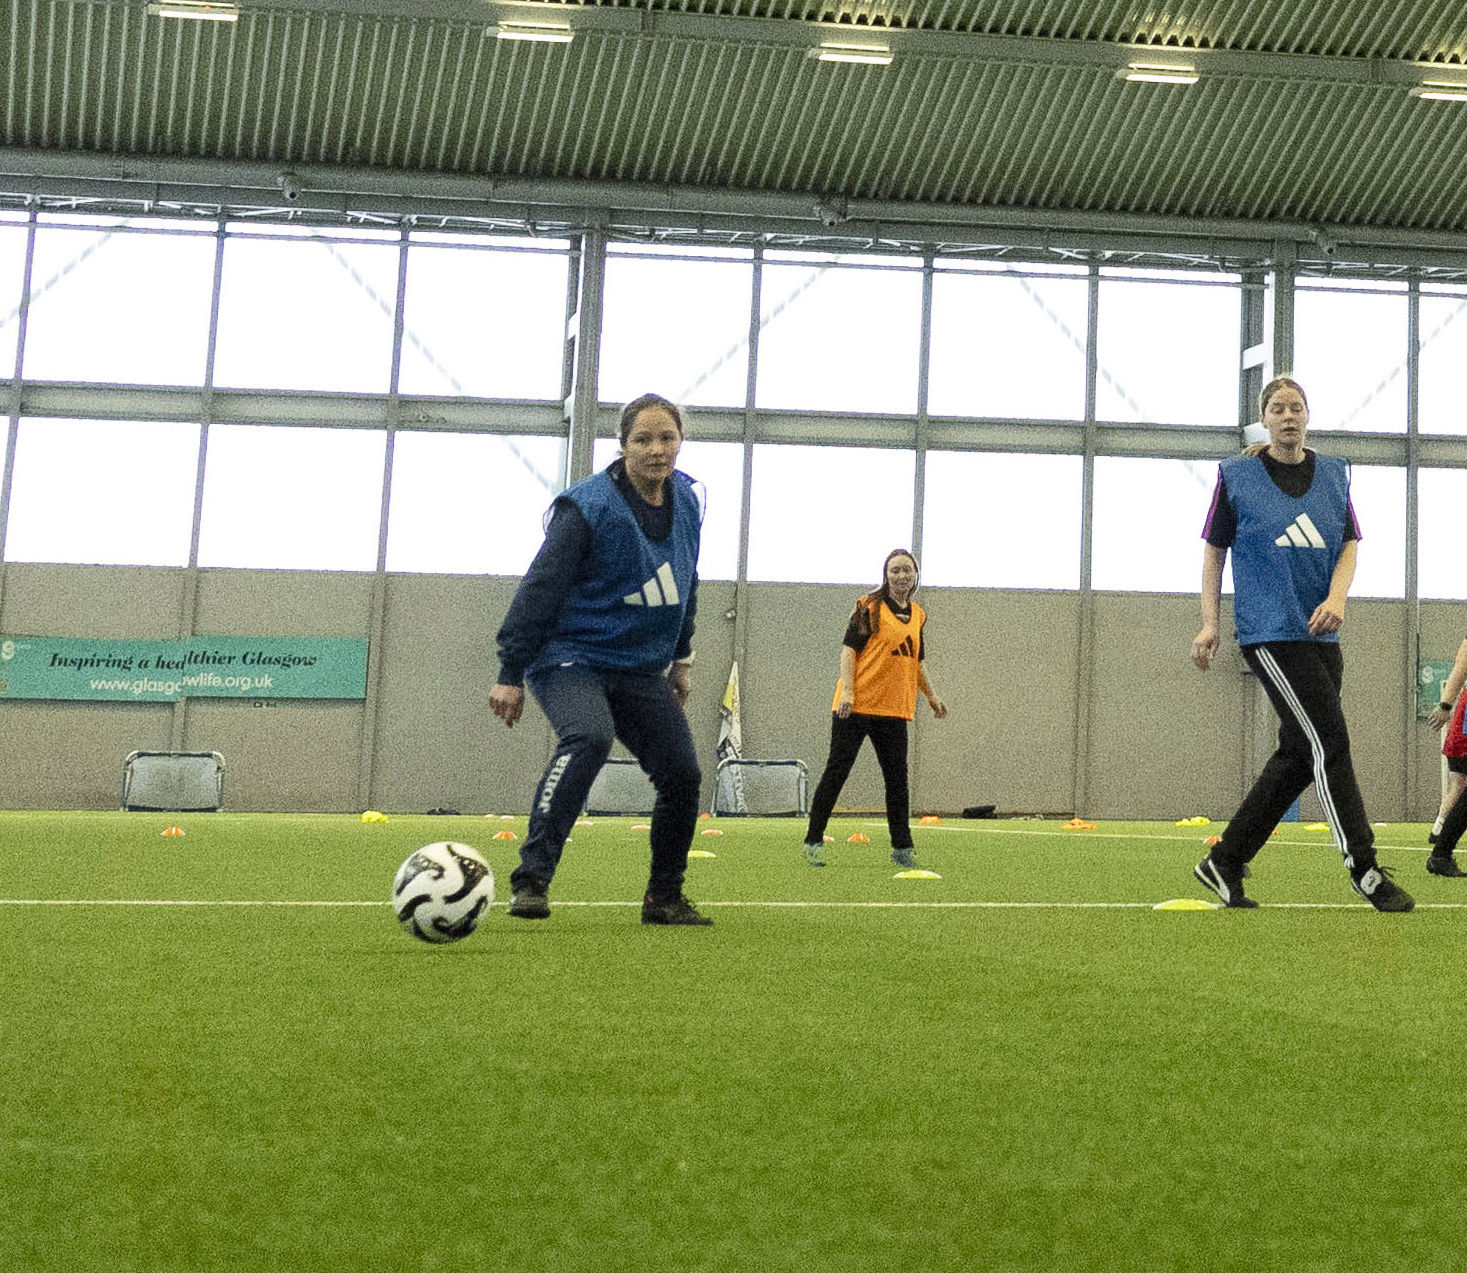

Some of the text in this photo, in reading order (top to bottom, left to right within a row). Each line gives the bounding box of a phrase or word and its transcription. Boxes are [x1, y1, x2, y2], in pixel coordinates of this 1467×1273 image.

[50, 650, 318, 671] Inspiring a healthier Glasgow
[89, 672, 273, 696] www.glasgowlife.org.uk
